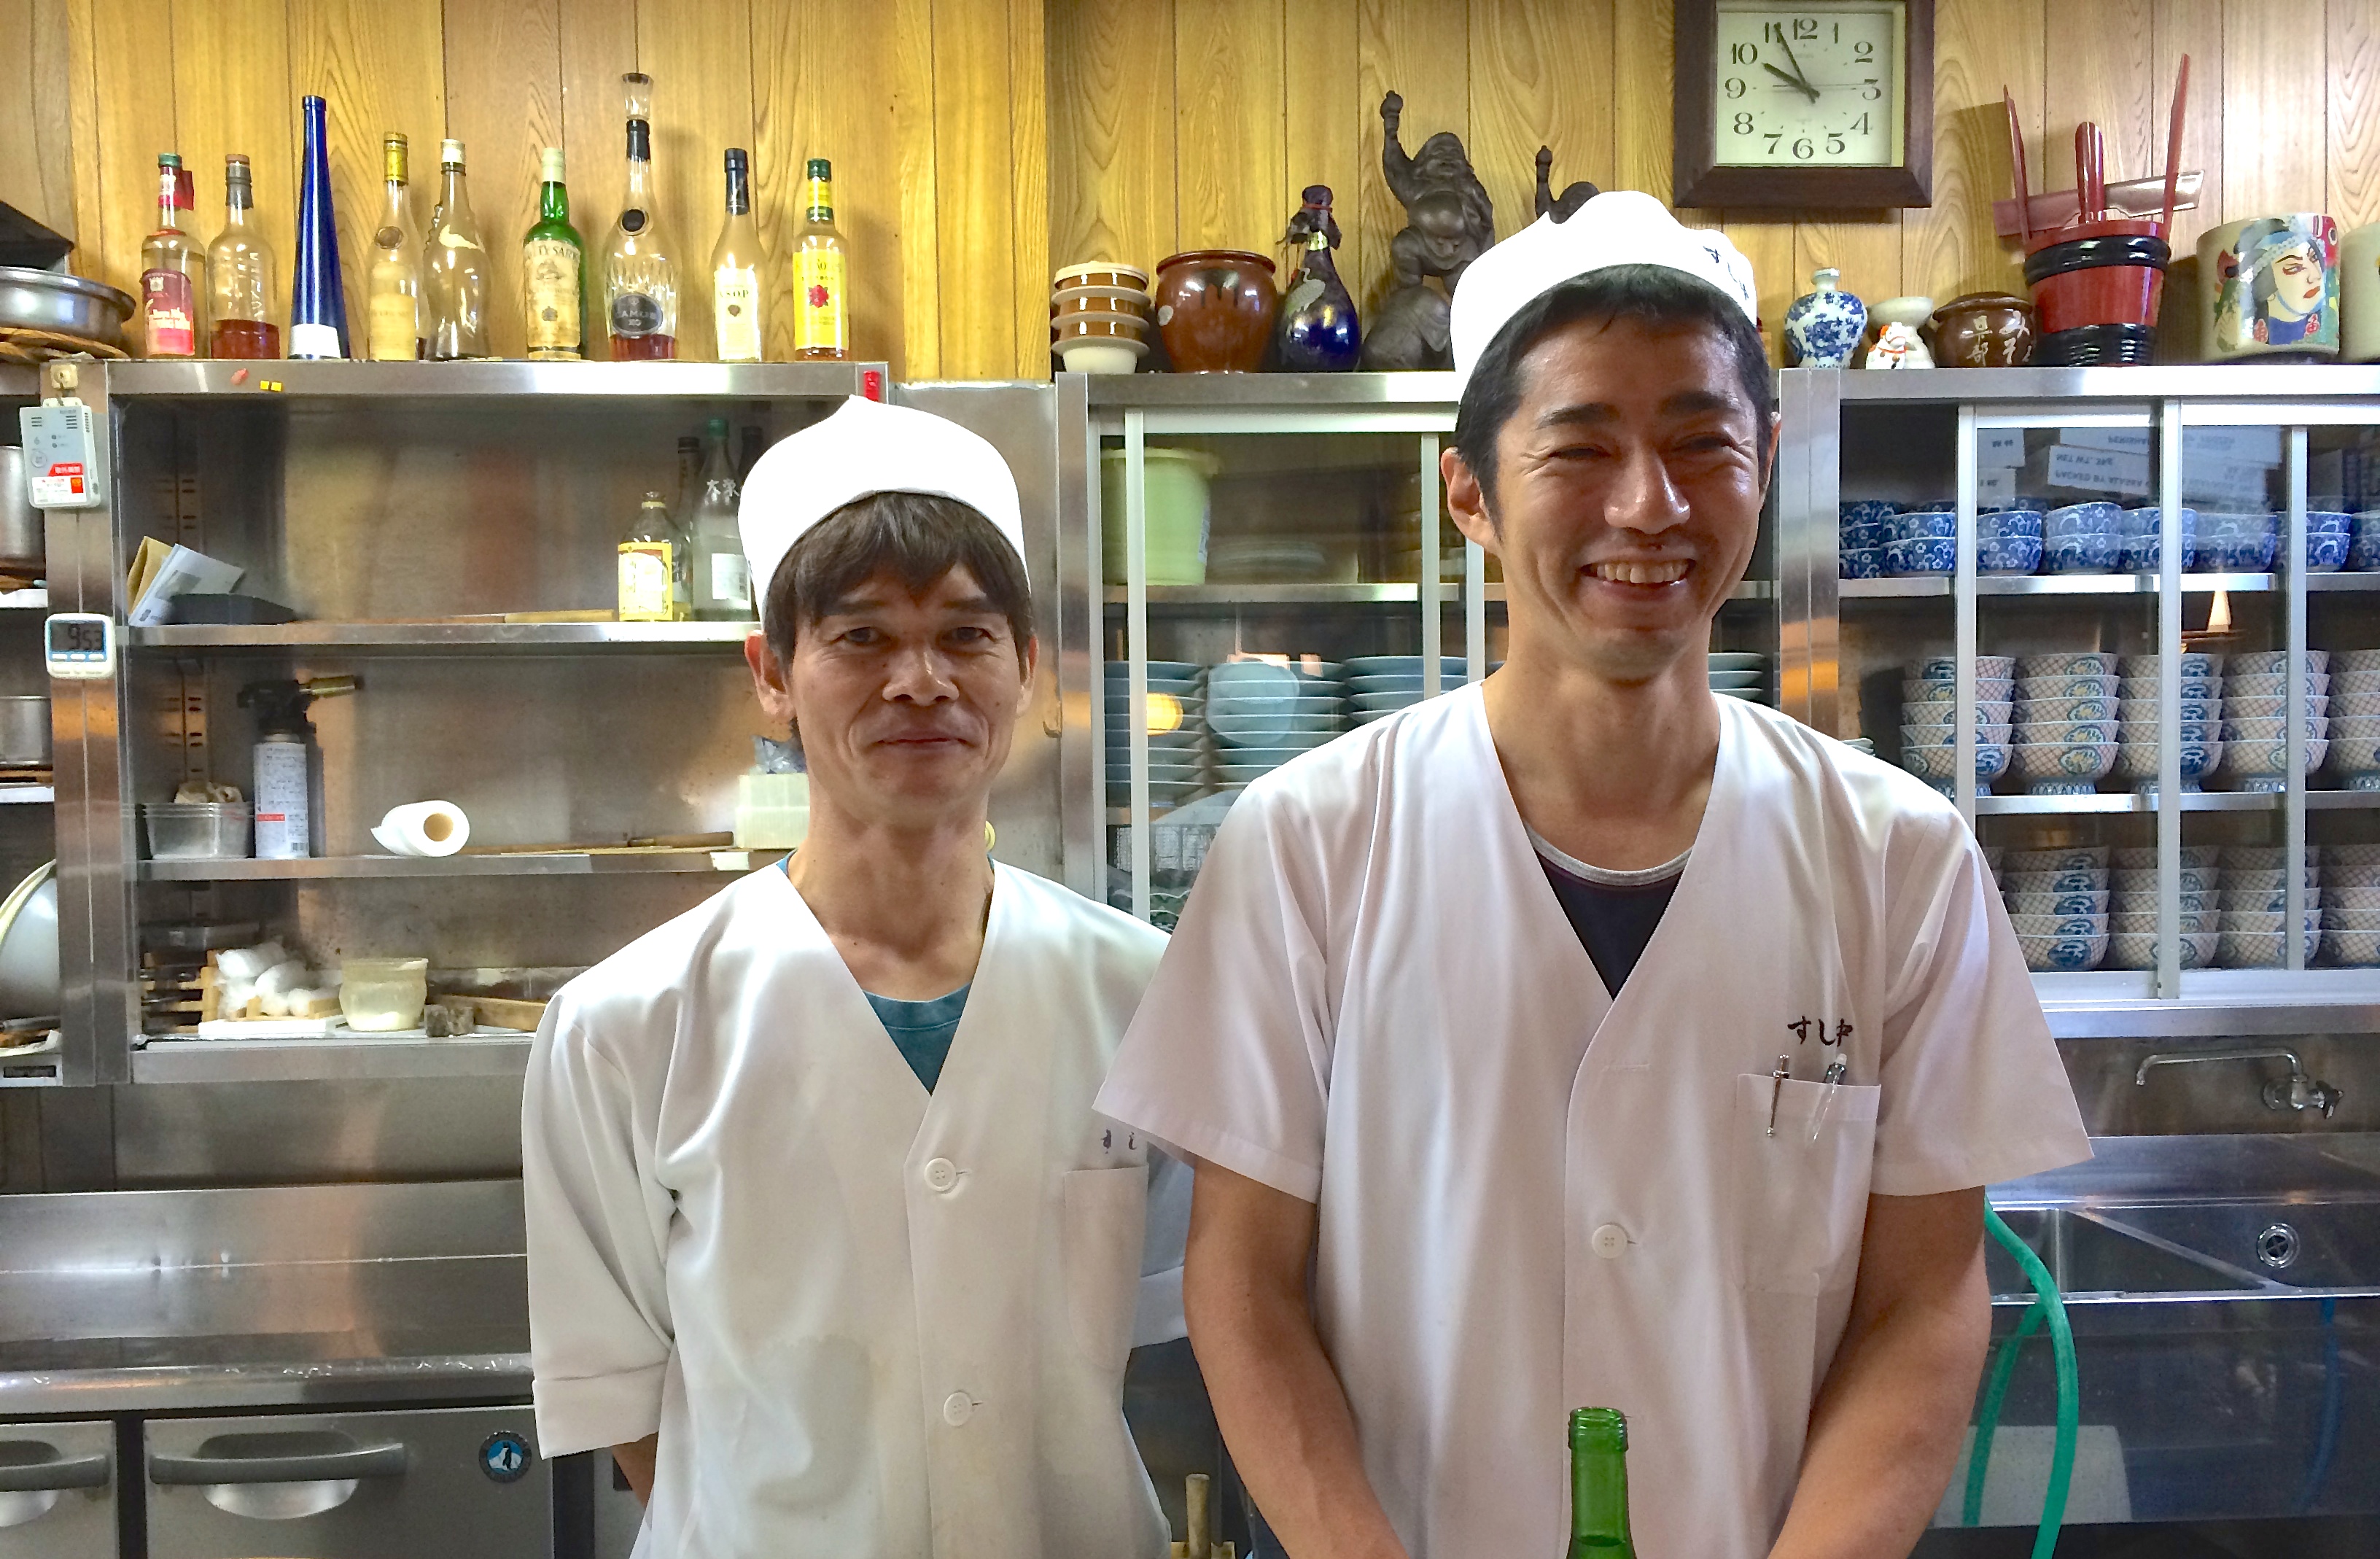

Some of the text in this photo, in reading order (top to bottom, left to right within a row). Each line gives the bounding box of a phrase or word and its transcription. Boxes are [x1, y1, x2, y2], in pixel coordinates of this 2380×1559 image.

[1793, 18, 1818, 40] 12
[1833, 22, 1839, 44] 1
[1731, 42, 1758, 65] 10
[1854, 41, 1873, 63] 2
[1724, 77, 1746, 99] 9
[1862, 79, 1881, 101] 3
[1733, 112, 1754, 135] 8
[1850, 112, 1872, 136] 4
[1763, 133, 1783, 155] 7
[1792, 138, 1814, 160] 6
[1825, 133, 1846, 155] 5
[1787, 1015, 1854, 1047] すしや
